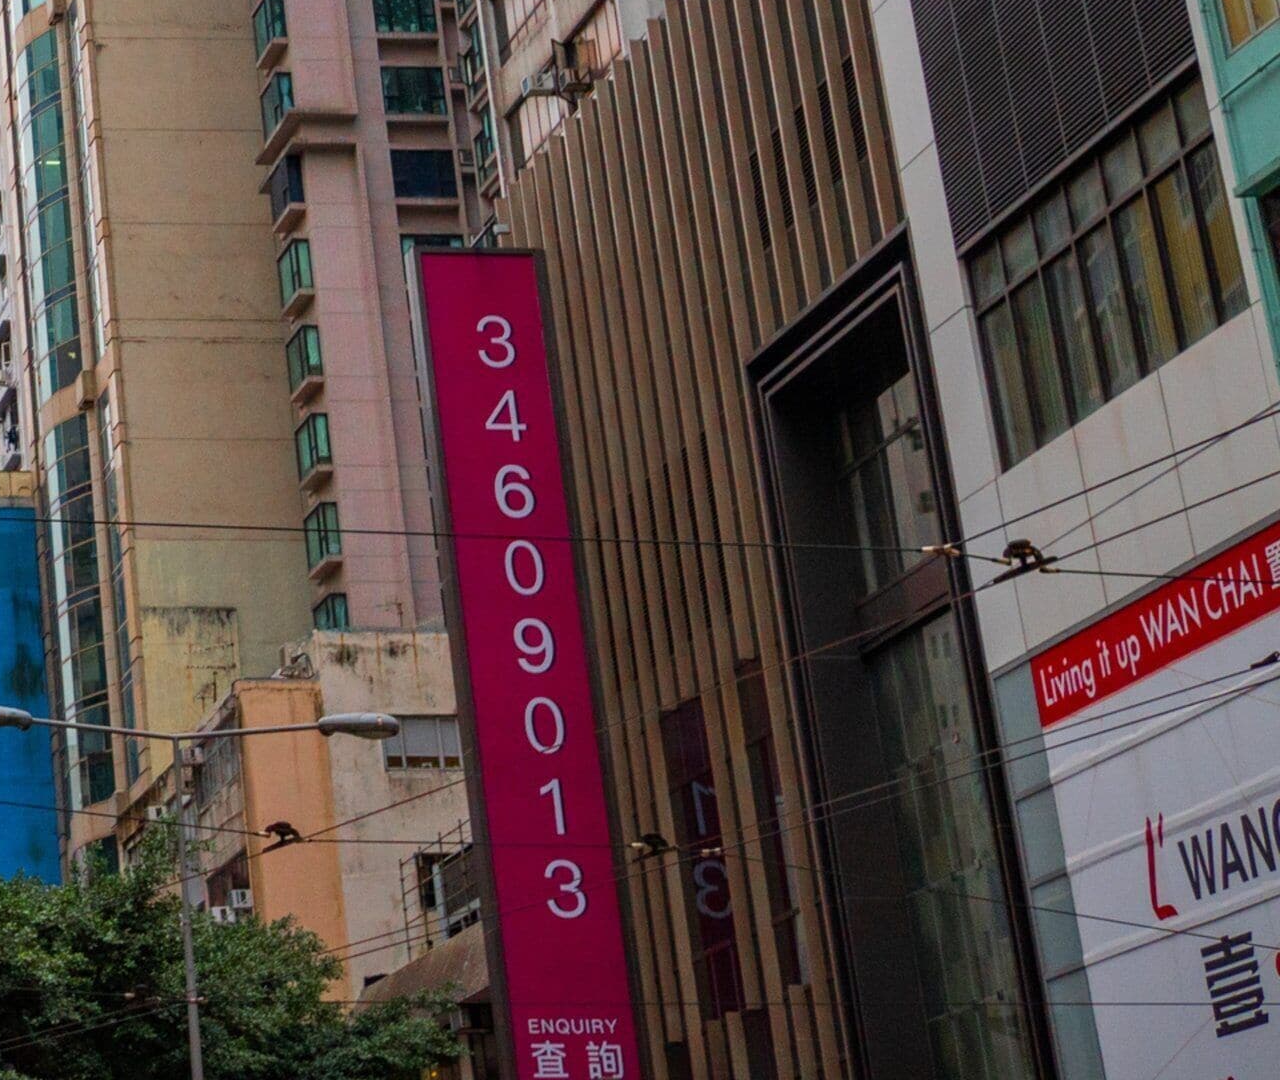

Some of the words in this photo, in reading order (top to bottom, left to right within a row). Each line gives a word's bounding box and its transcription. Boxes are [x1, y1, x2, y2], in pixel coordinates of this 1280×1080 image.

[476, 315, 587, 919] 34609013
[1040, 658, 1097, 708] Living
[1096, 639, 1112, 678] it
[1115, 634, 1141, 677] up
[1140, 586, 1202, 653] WAN
[1203, 553, 1264, 621] CHAI
[527, 1018, 618, 1035] ENQUIRY
[530, 1040, 625, 1079] 查詢
